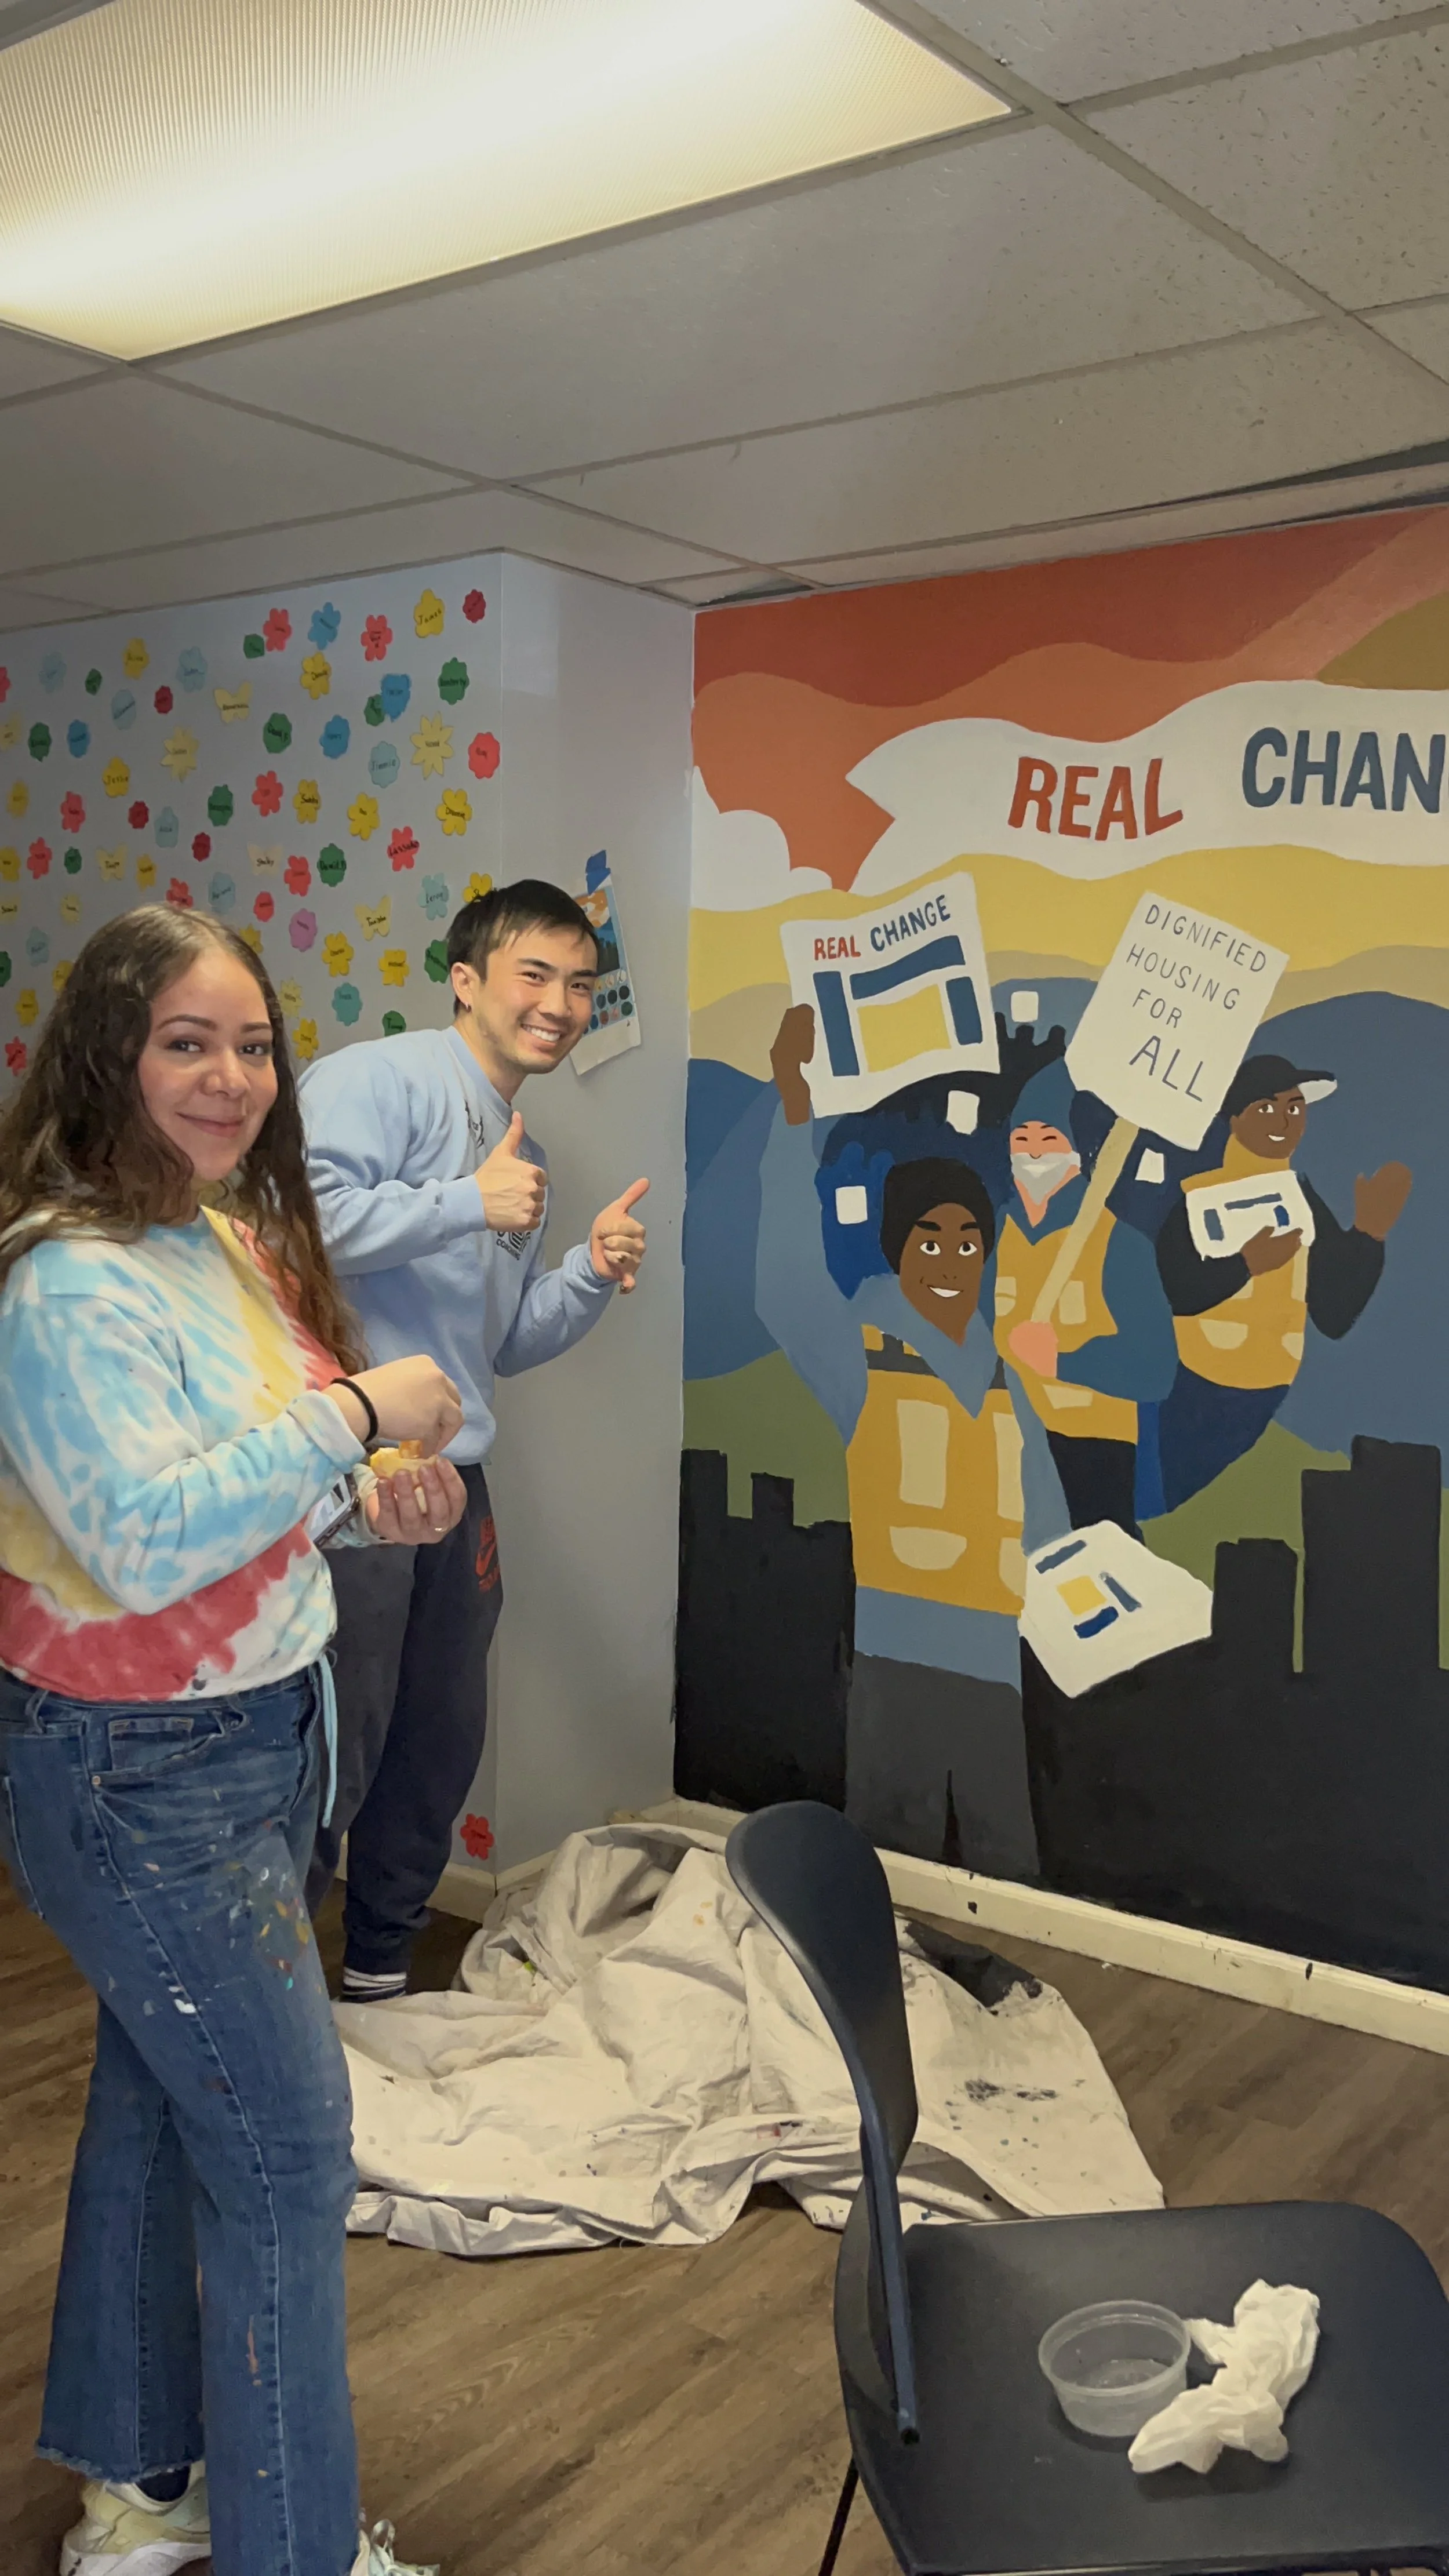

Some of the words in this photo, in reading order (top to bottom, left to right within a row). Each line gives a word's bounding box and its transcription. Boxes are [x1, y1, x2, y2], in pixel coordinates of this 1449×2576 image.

[418, 607, 442, 626] James
[1008, 756, 1184, 841] REAL
[1242, 727, 1449, 814] CHAN
[814, 935, 861, 960] REAL
[870, 894, 951, 952] CHANGE
[1145, 904, 1266, 972] DIGNIFIED
[1126, 943, 1240, 1010] HOUSING
[1132, 988, 1182, 1028] FOR
[1129, 1035, 1203, 1103] ALL
